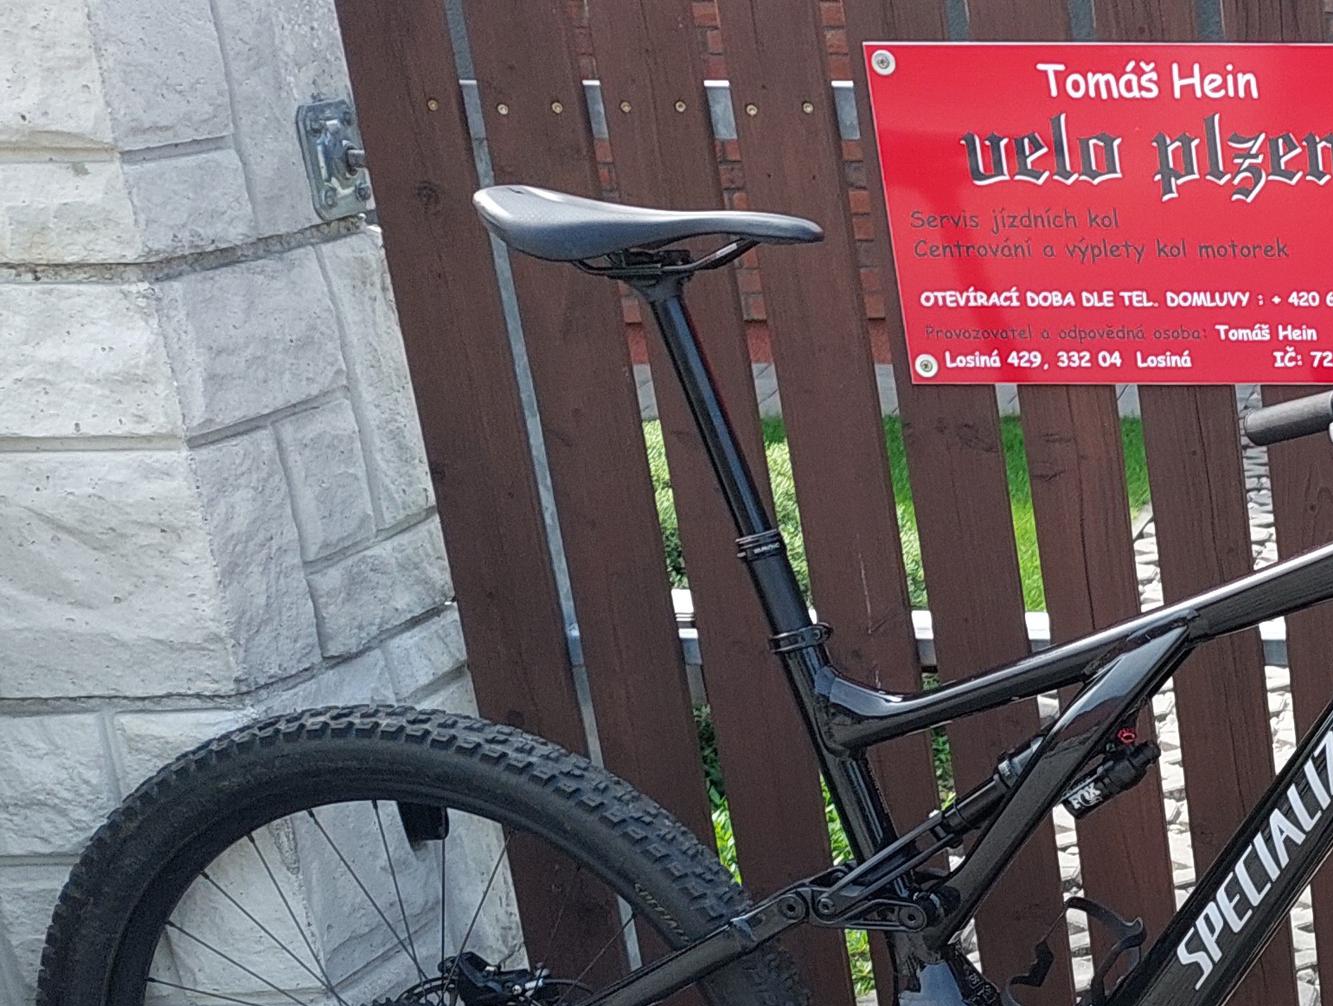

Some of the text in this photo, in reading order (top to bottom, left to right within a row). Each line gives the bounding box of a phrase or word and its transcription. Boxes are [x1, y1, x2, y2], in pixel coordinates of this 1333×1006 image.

[1036, 60, 1259, 99] Tomáš Hein
[961, 113, 1123, 186] velo
[910, 208, 1119, 235] Servis jízdních kol
[913, 238, 1290, 264] Centrování a výplety kol motorek
[919, 286, 1020, 308] OTEVÍRACÍ
[1025, 291, 1075, 307] DOBA
[1081, 291, 1115, 307] DLE
[1119, 291, 1160, 307] TEL.
[1165, 291, 1250, 308] DOMLUVY
[1287, 291, 1320, 307] 420
[924, 323, 1318, 344] Provozovatel a odpovědná osoba: Tomáš Hein
[944, 350, 1002, 369] Losiná
[1006, 350, 1051, 371] 429,
[1056, 351, 1092, 368] 332
[1097, 351, 1123, 368] 04
[1136, 350, 1193, 368] Losiná
[1272, 346, 1303, 368] IČ:
